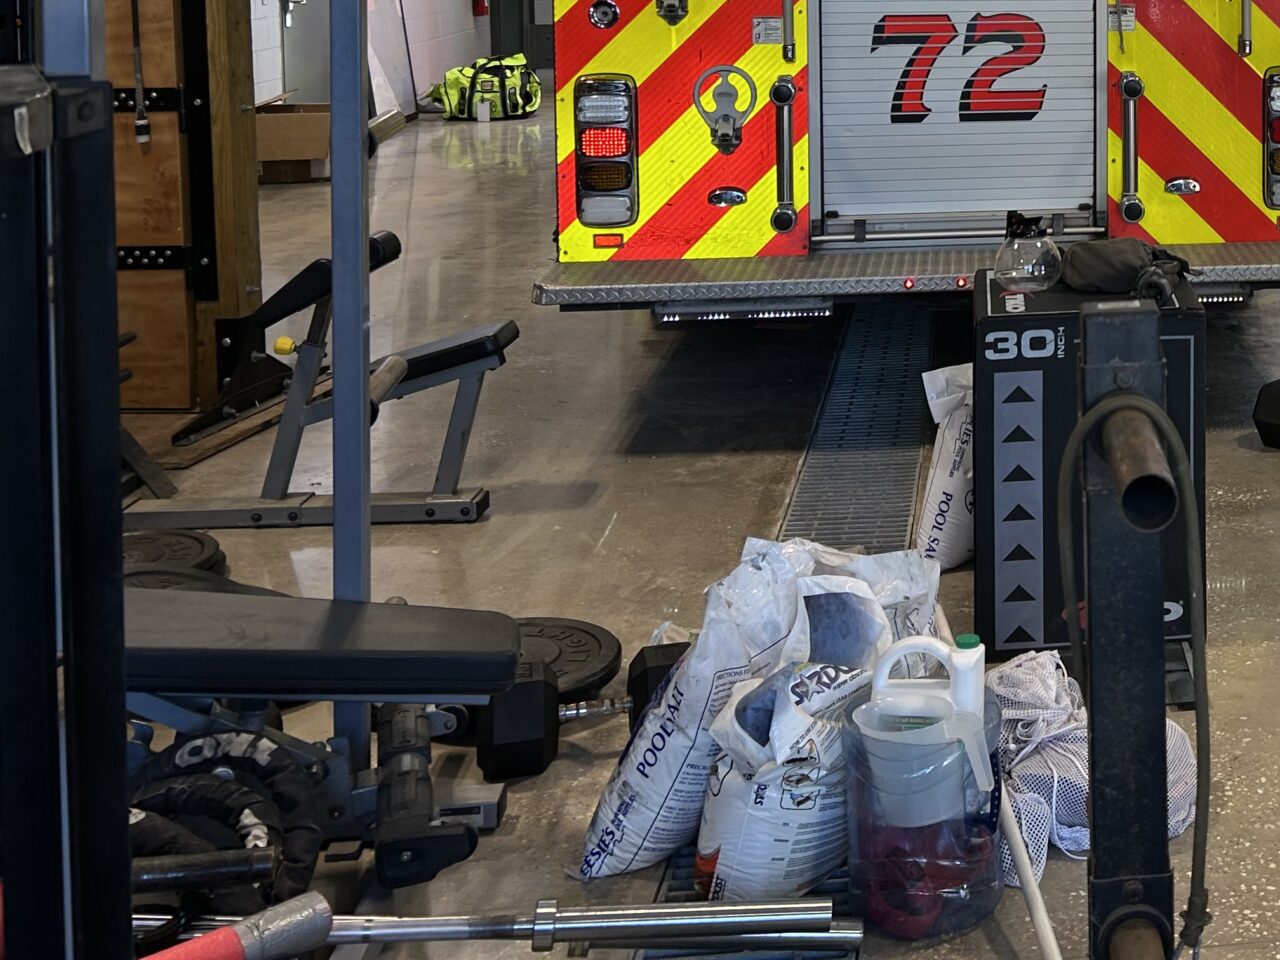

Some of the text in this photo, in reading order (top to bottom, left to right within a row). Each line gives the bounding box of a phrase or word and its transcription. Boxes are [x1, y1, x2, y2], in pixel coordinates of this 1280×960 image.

[870, 12, 1048, 124] 72
[984, 326, 1065, 361] 30 INCH
[924, 490, 954, 561] POOL SA
[636, 715, 675, 778] POOL
